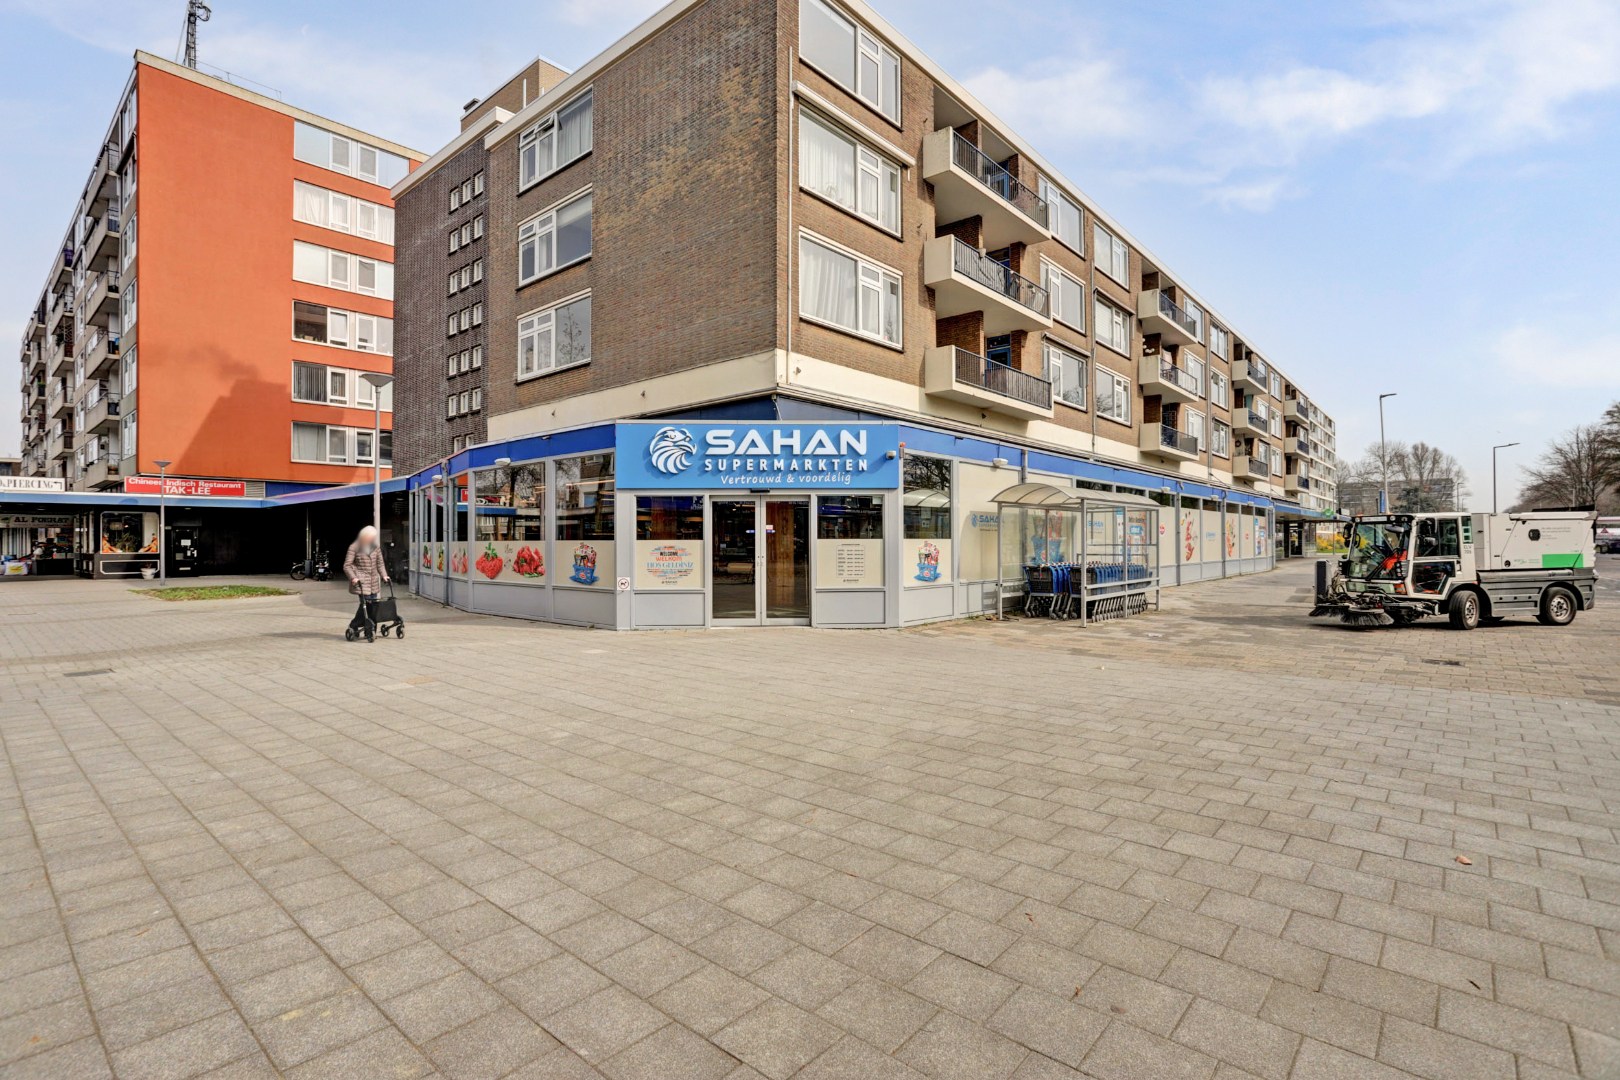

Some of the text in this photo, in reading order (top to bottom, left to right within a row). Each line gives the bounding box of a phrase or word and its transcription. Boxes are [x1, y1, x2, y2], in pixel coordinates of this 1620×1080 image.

[705, 429, 867, 455] SAHAN
[704, 458, 868, 472] SUPERMARKTEN
[166, 479, 196, 487] Indisch
[199, 481, 242, 489] Restaurant
[721, 473, 851, 485] Vertrouwd & voordelig
